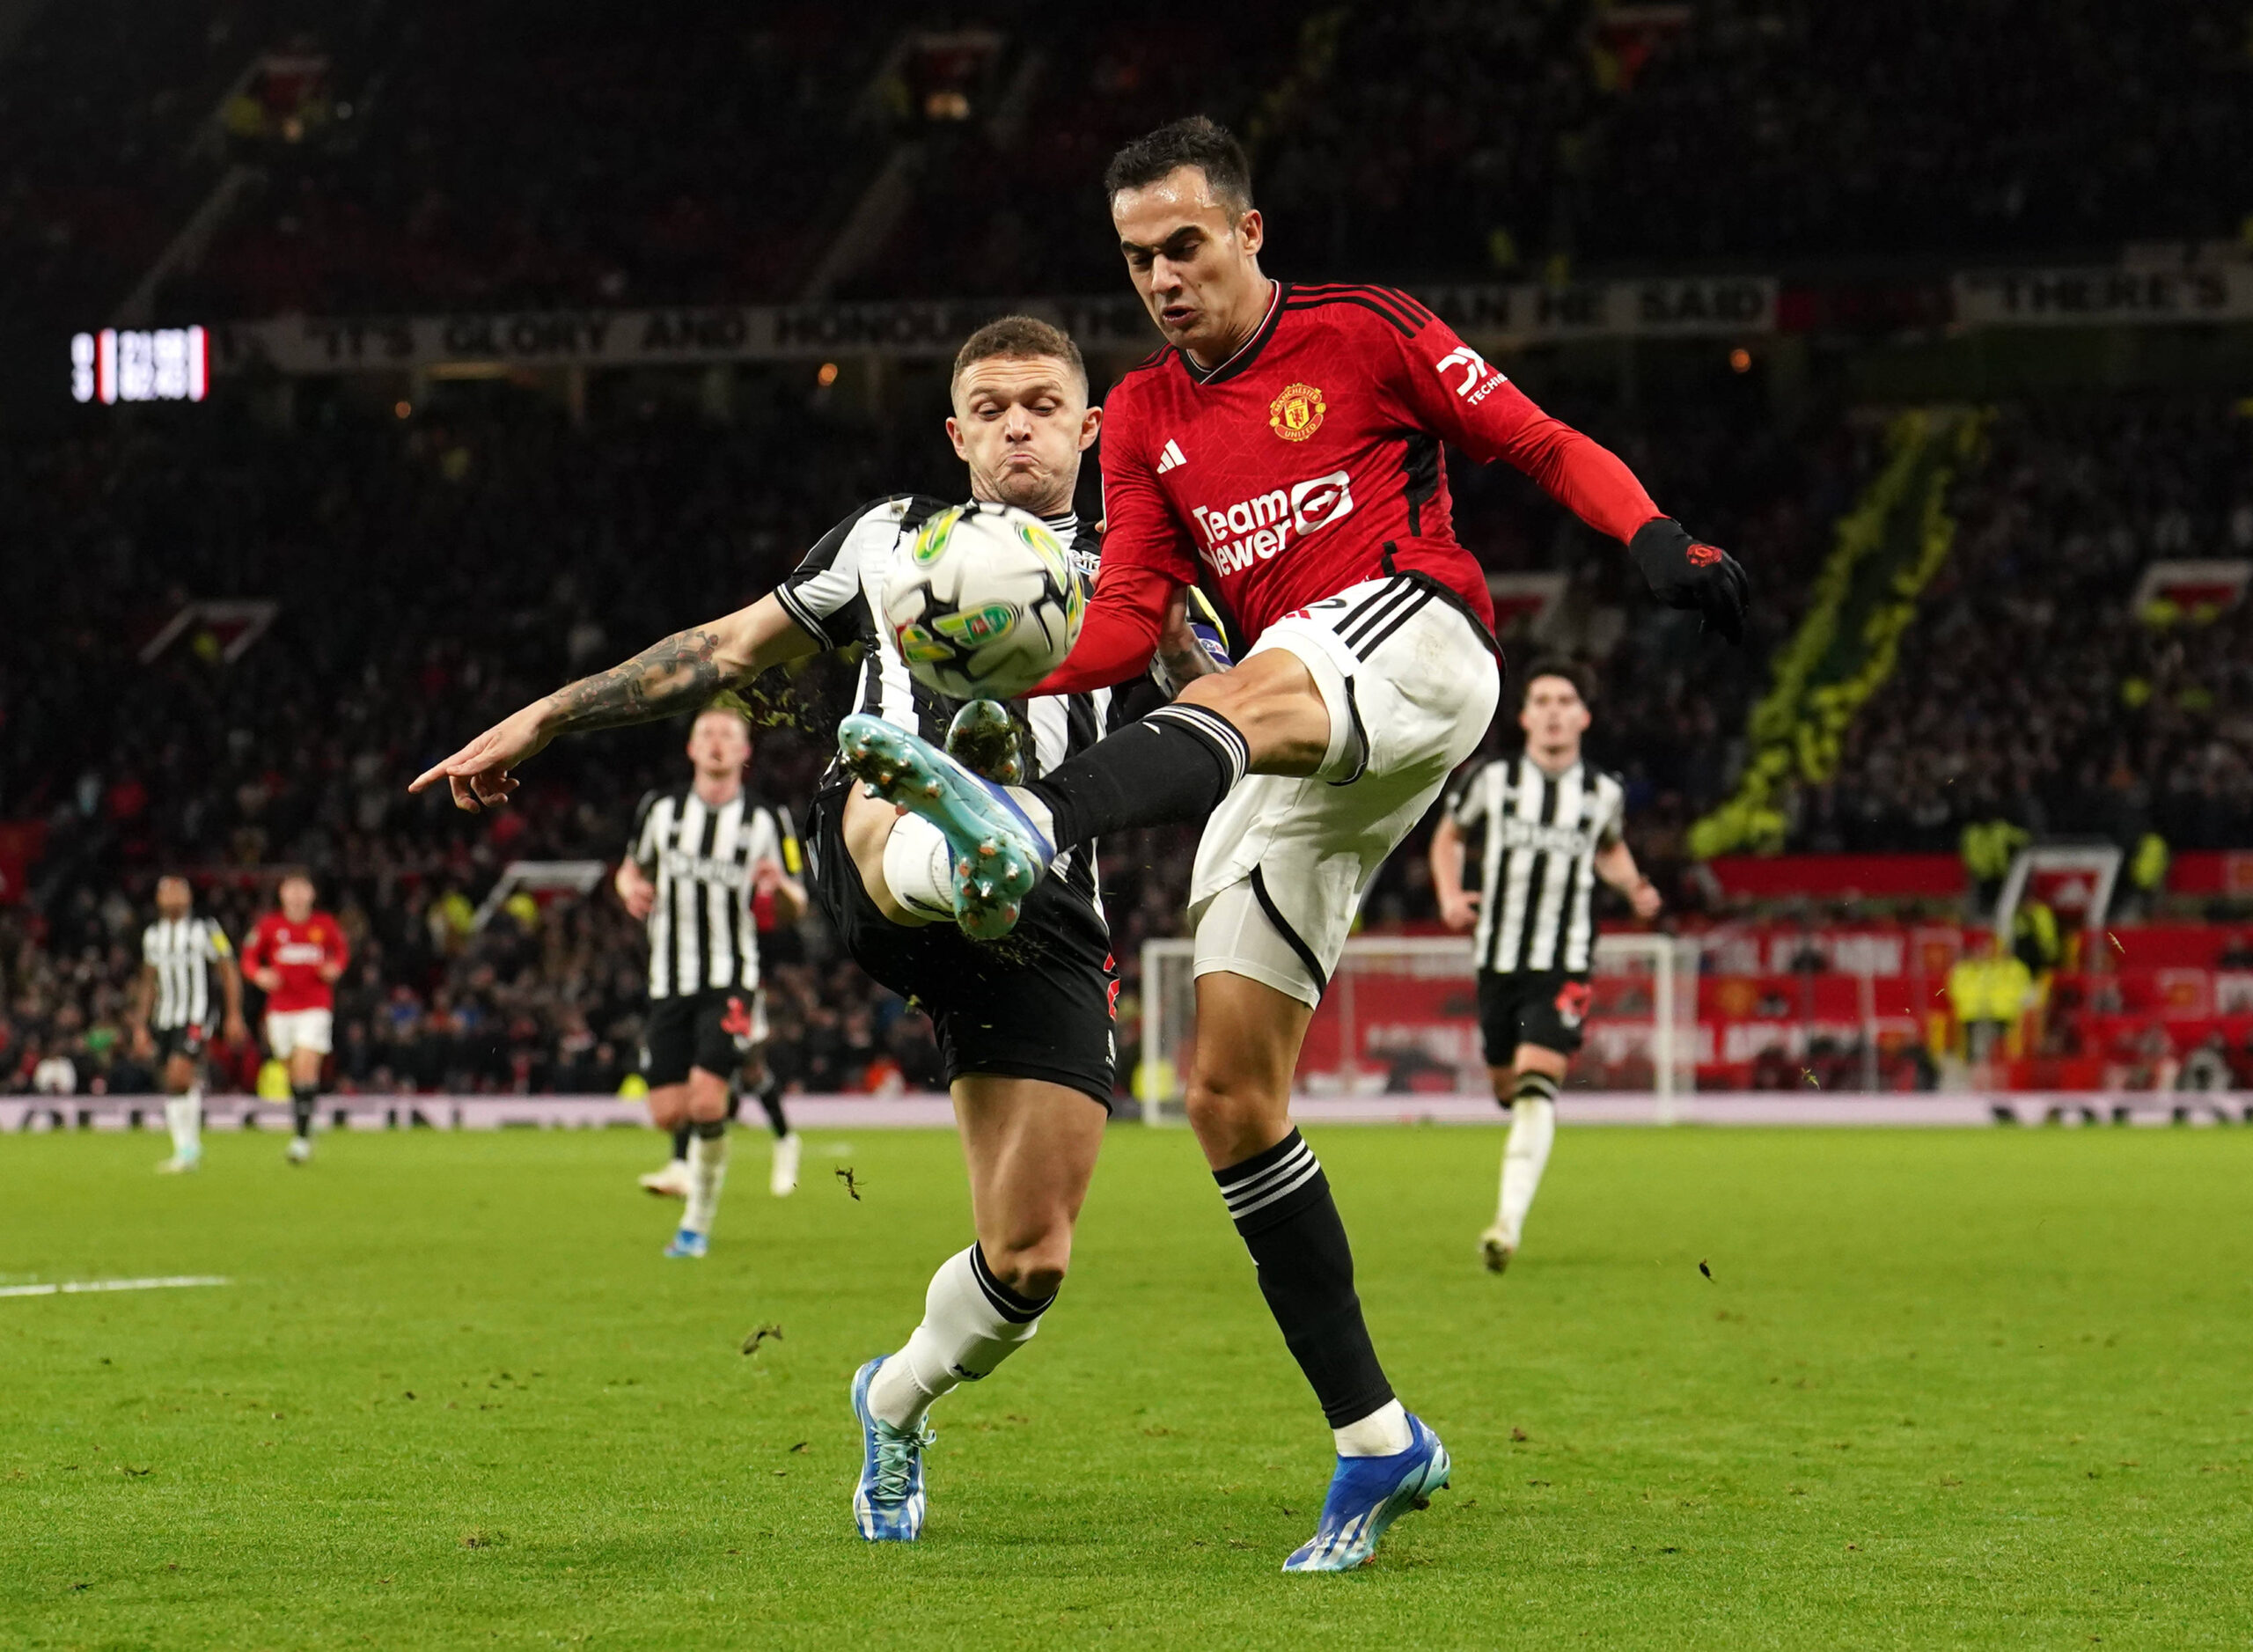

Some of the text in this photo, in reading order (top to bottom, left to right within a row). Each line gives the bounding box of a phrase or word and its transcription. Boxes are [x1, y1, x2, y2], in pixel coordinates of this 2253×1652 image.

[1274, 386, 1319, 413] MANCHESTER
[1284, 422, 1317, 437] UNITED
[1192, 489, 1288, 544] Team
